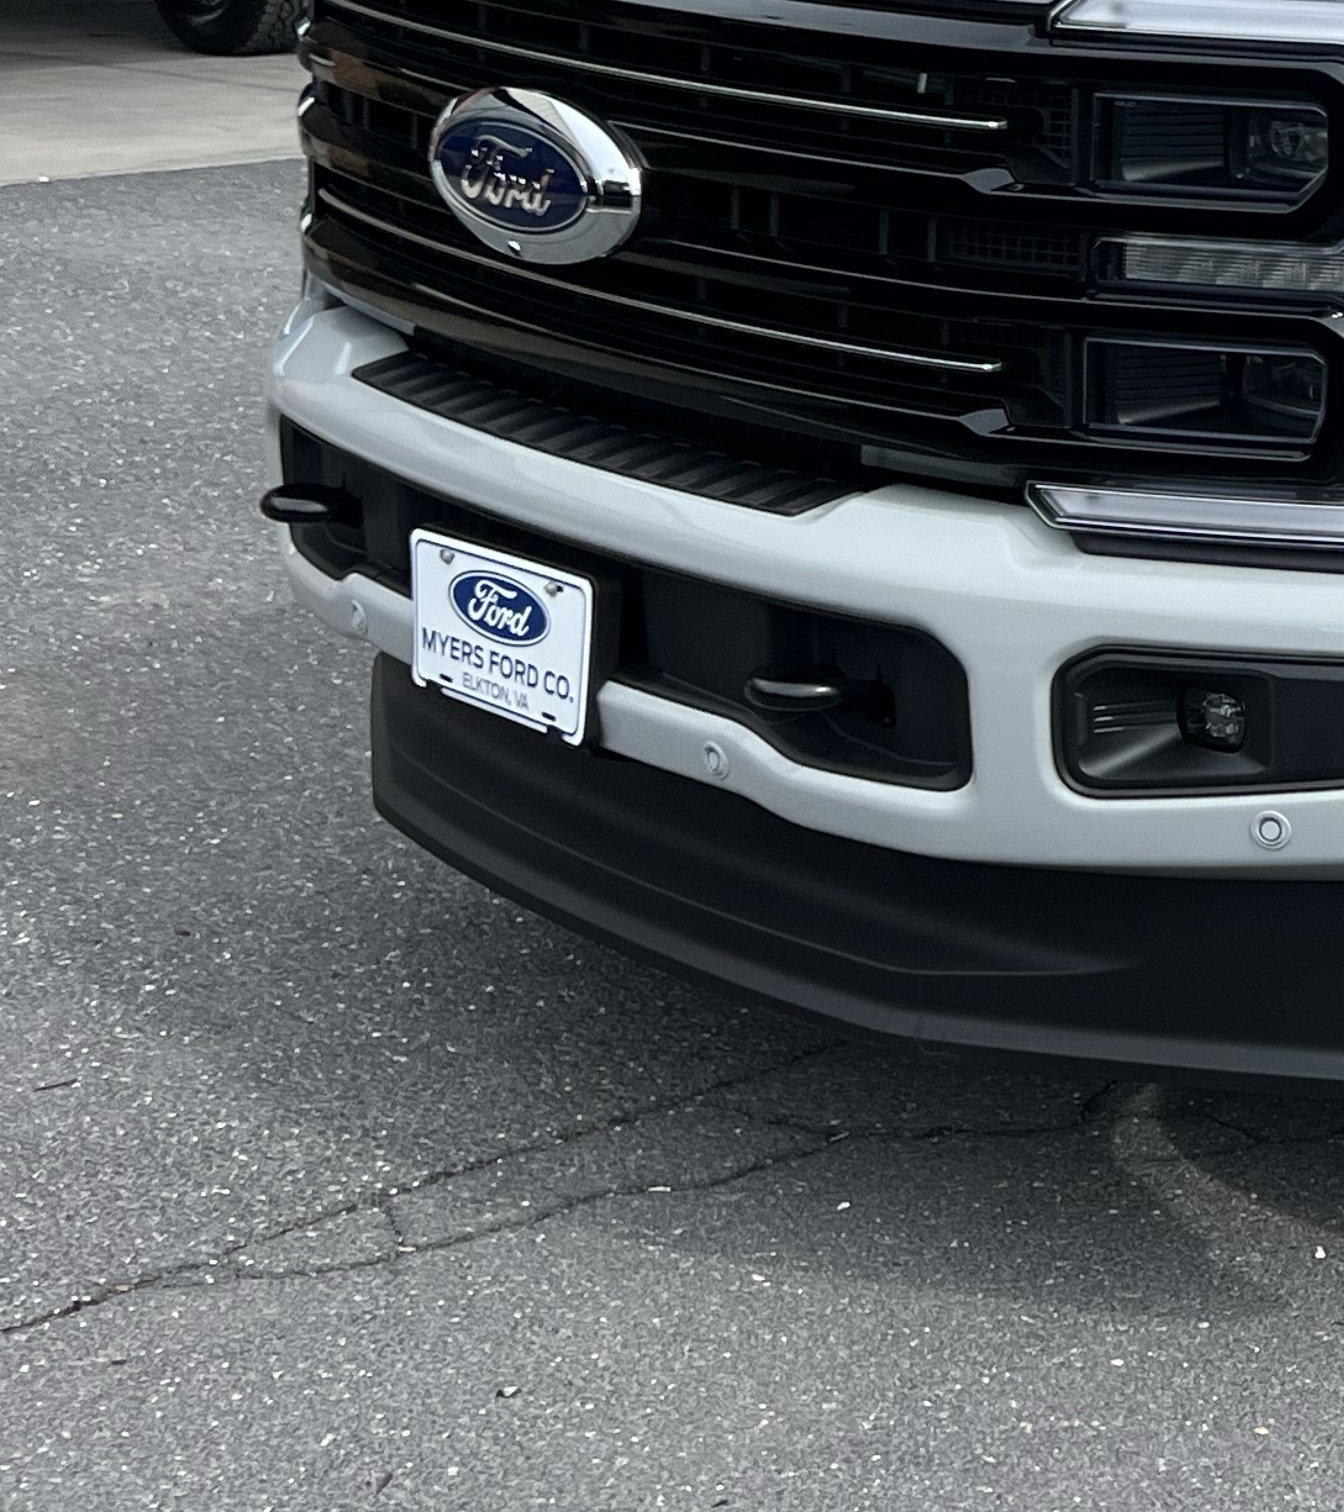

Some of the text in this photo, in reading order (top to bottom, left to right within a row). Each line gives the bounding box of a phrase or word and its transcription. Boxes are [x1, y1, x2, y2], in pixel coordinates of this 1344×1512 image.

[461, 134, 555, 217] Ford
[467, 579, 533, 637] Ford
[421, 626, 575, 704] MYERS FORD CO.
[513, 690, 530, 712] VA
